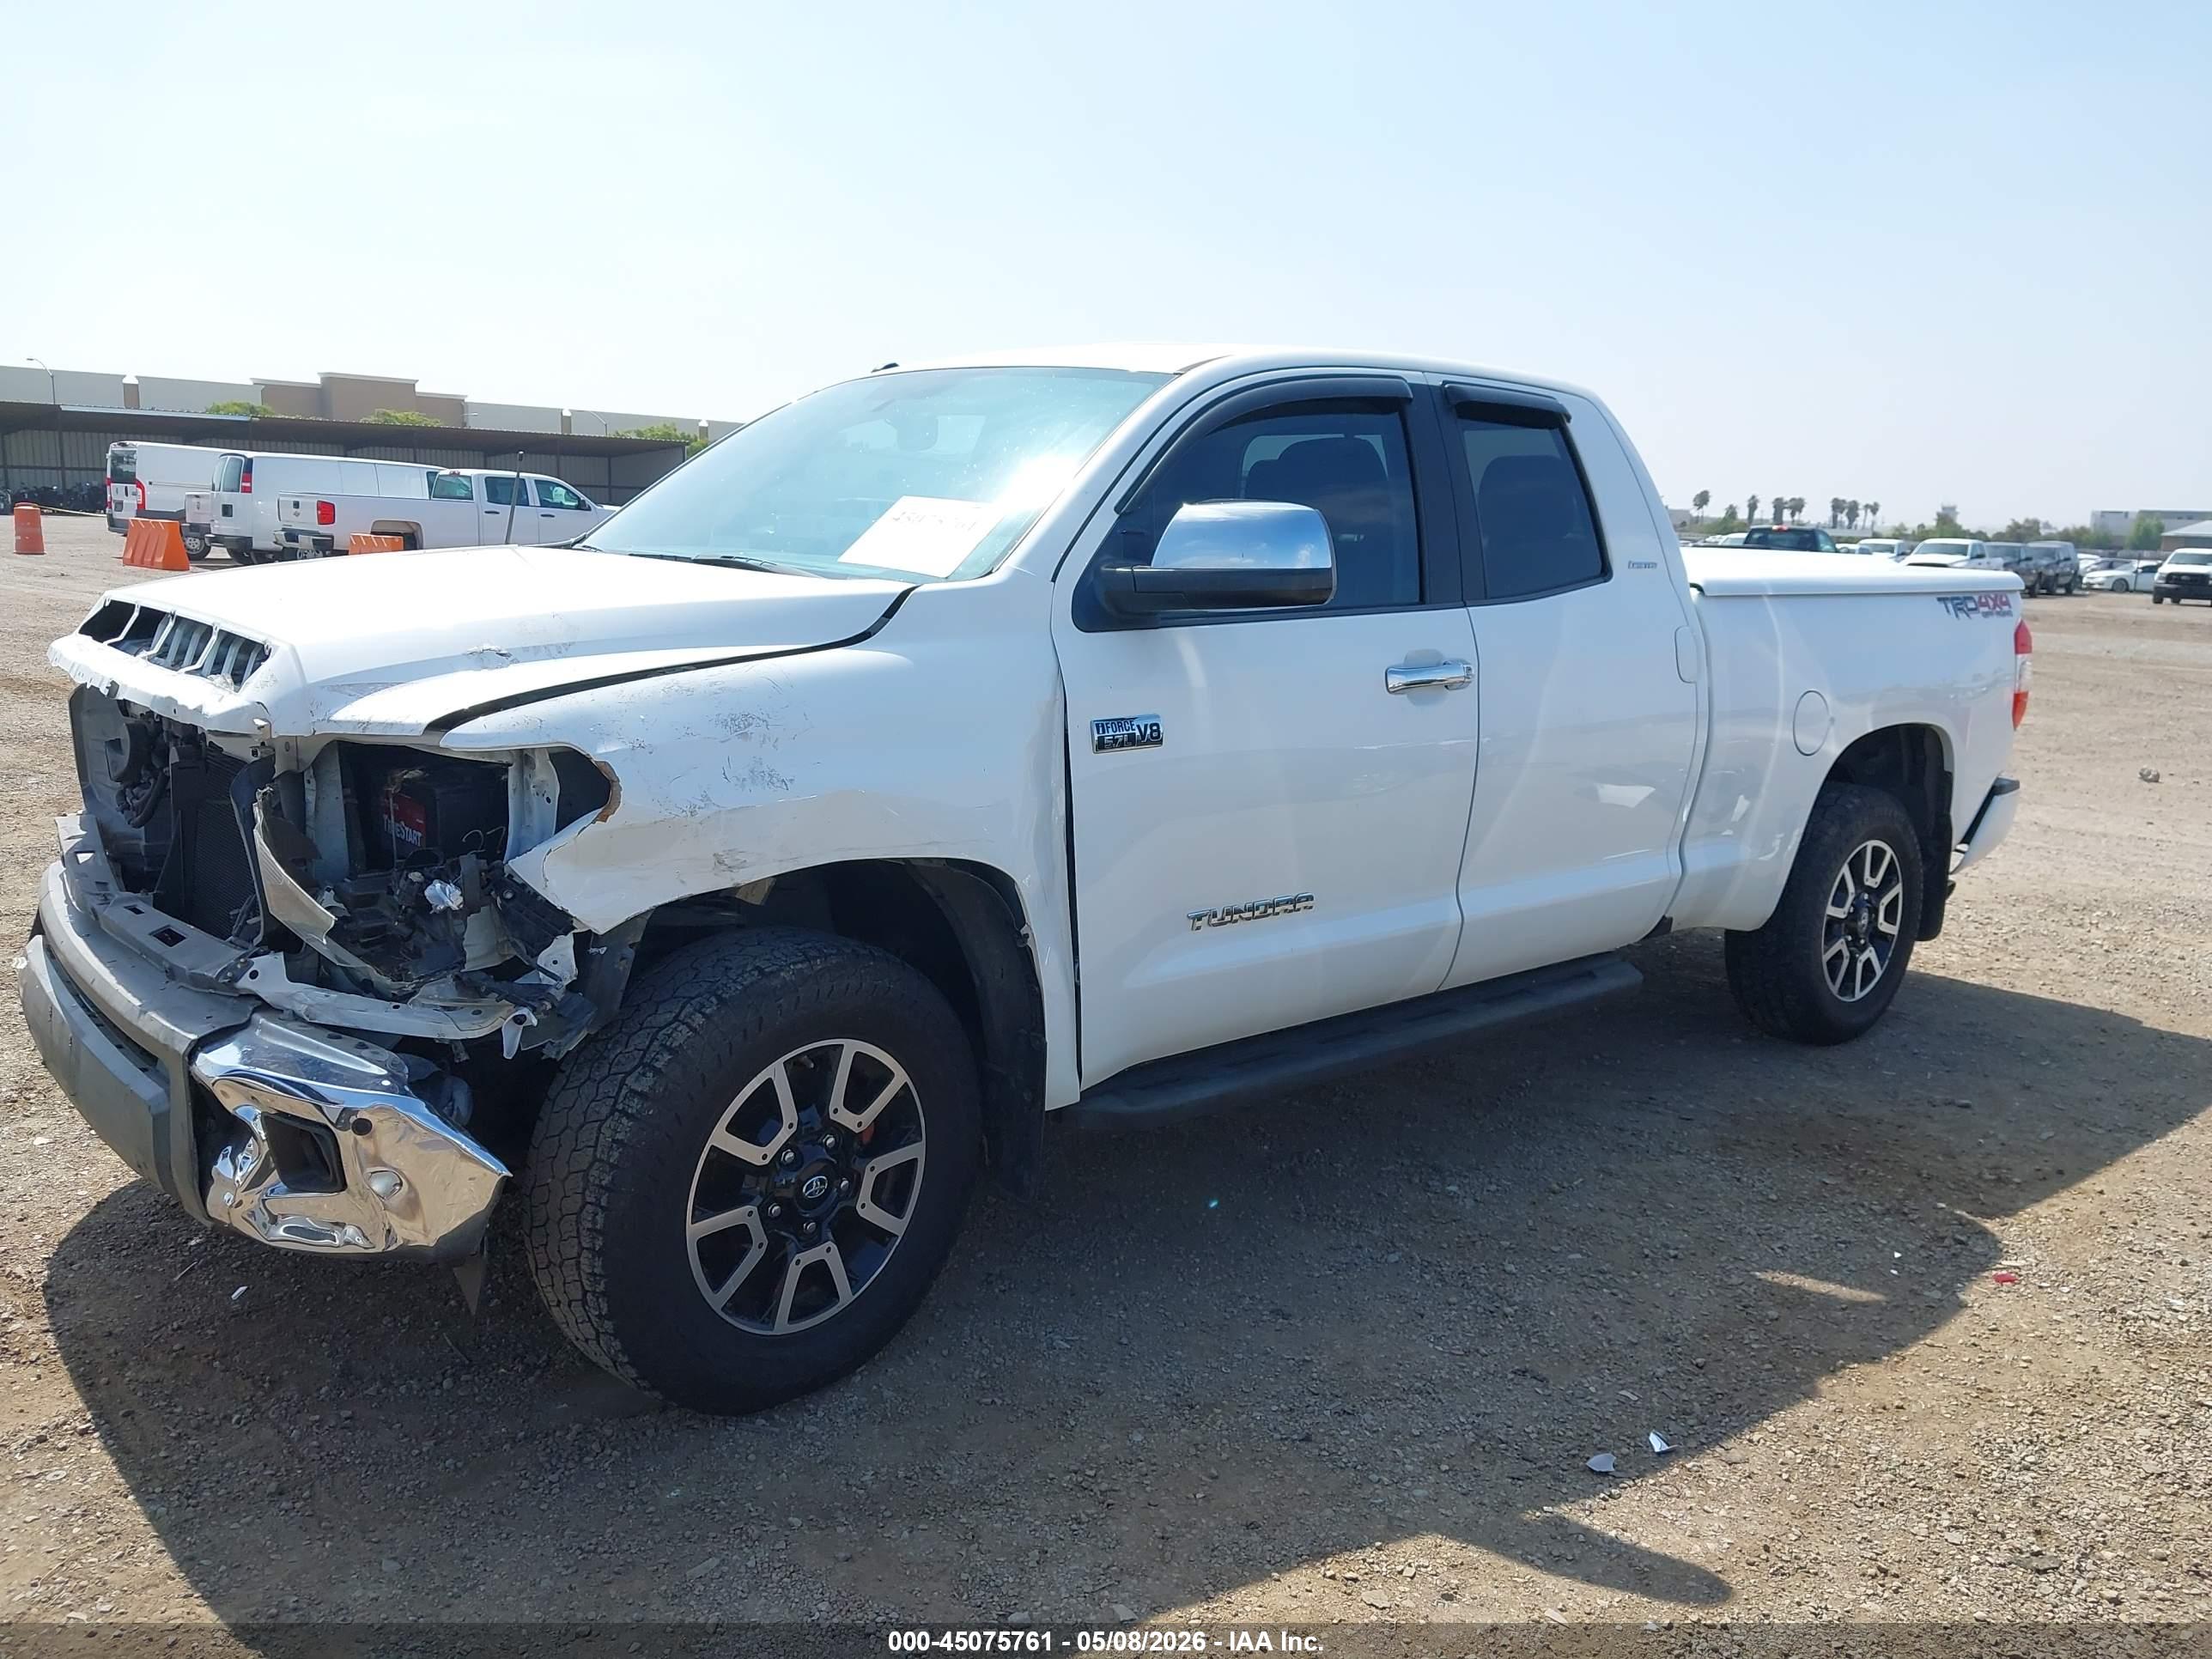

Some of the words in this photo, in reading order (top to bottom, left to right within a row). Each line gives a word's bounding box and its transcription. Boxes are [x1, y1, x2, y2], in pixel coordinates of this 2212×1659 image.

[1936, 596, 1980, 620] TRD
[1103, 733, 1133, 750] 5.7L
[1136, 722, 1162, 743] V8
[382, 813, 422, 848] TRESTART
[1187, 891, 1316, 932] TUNDRA
